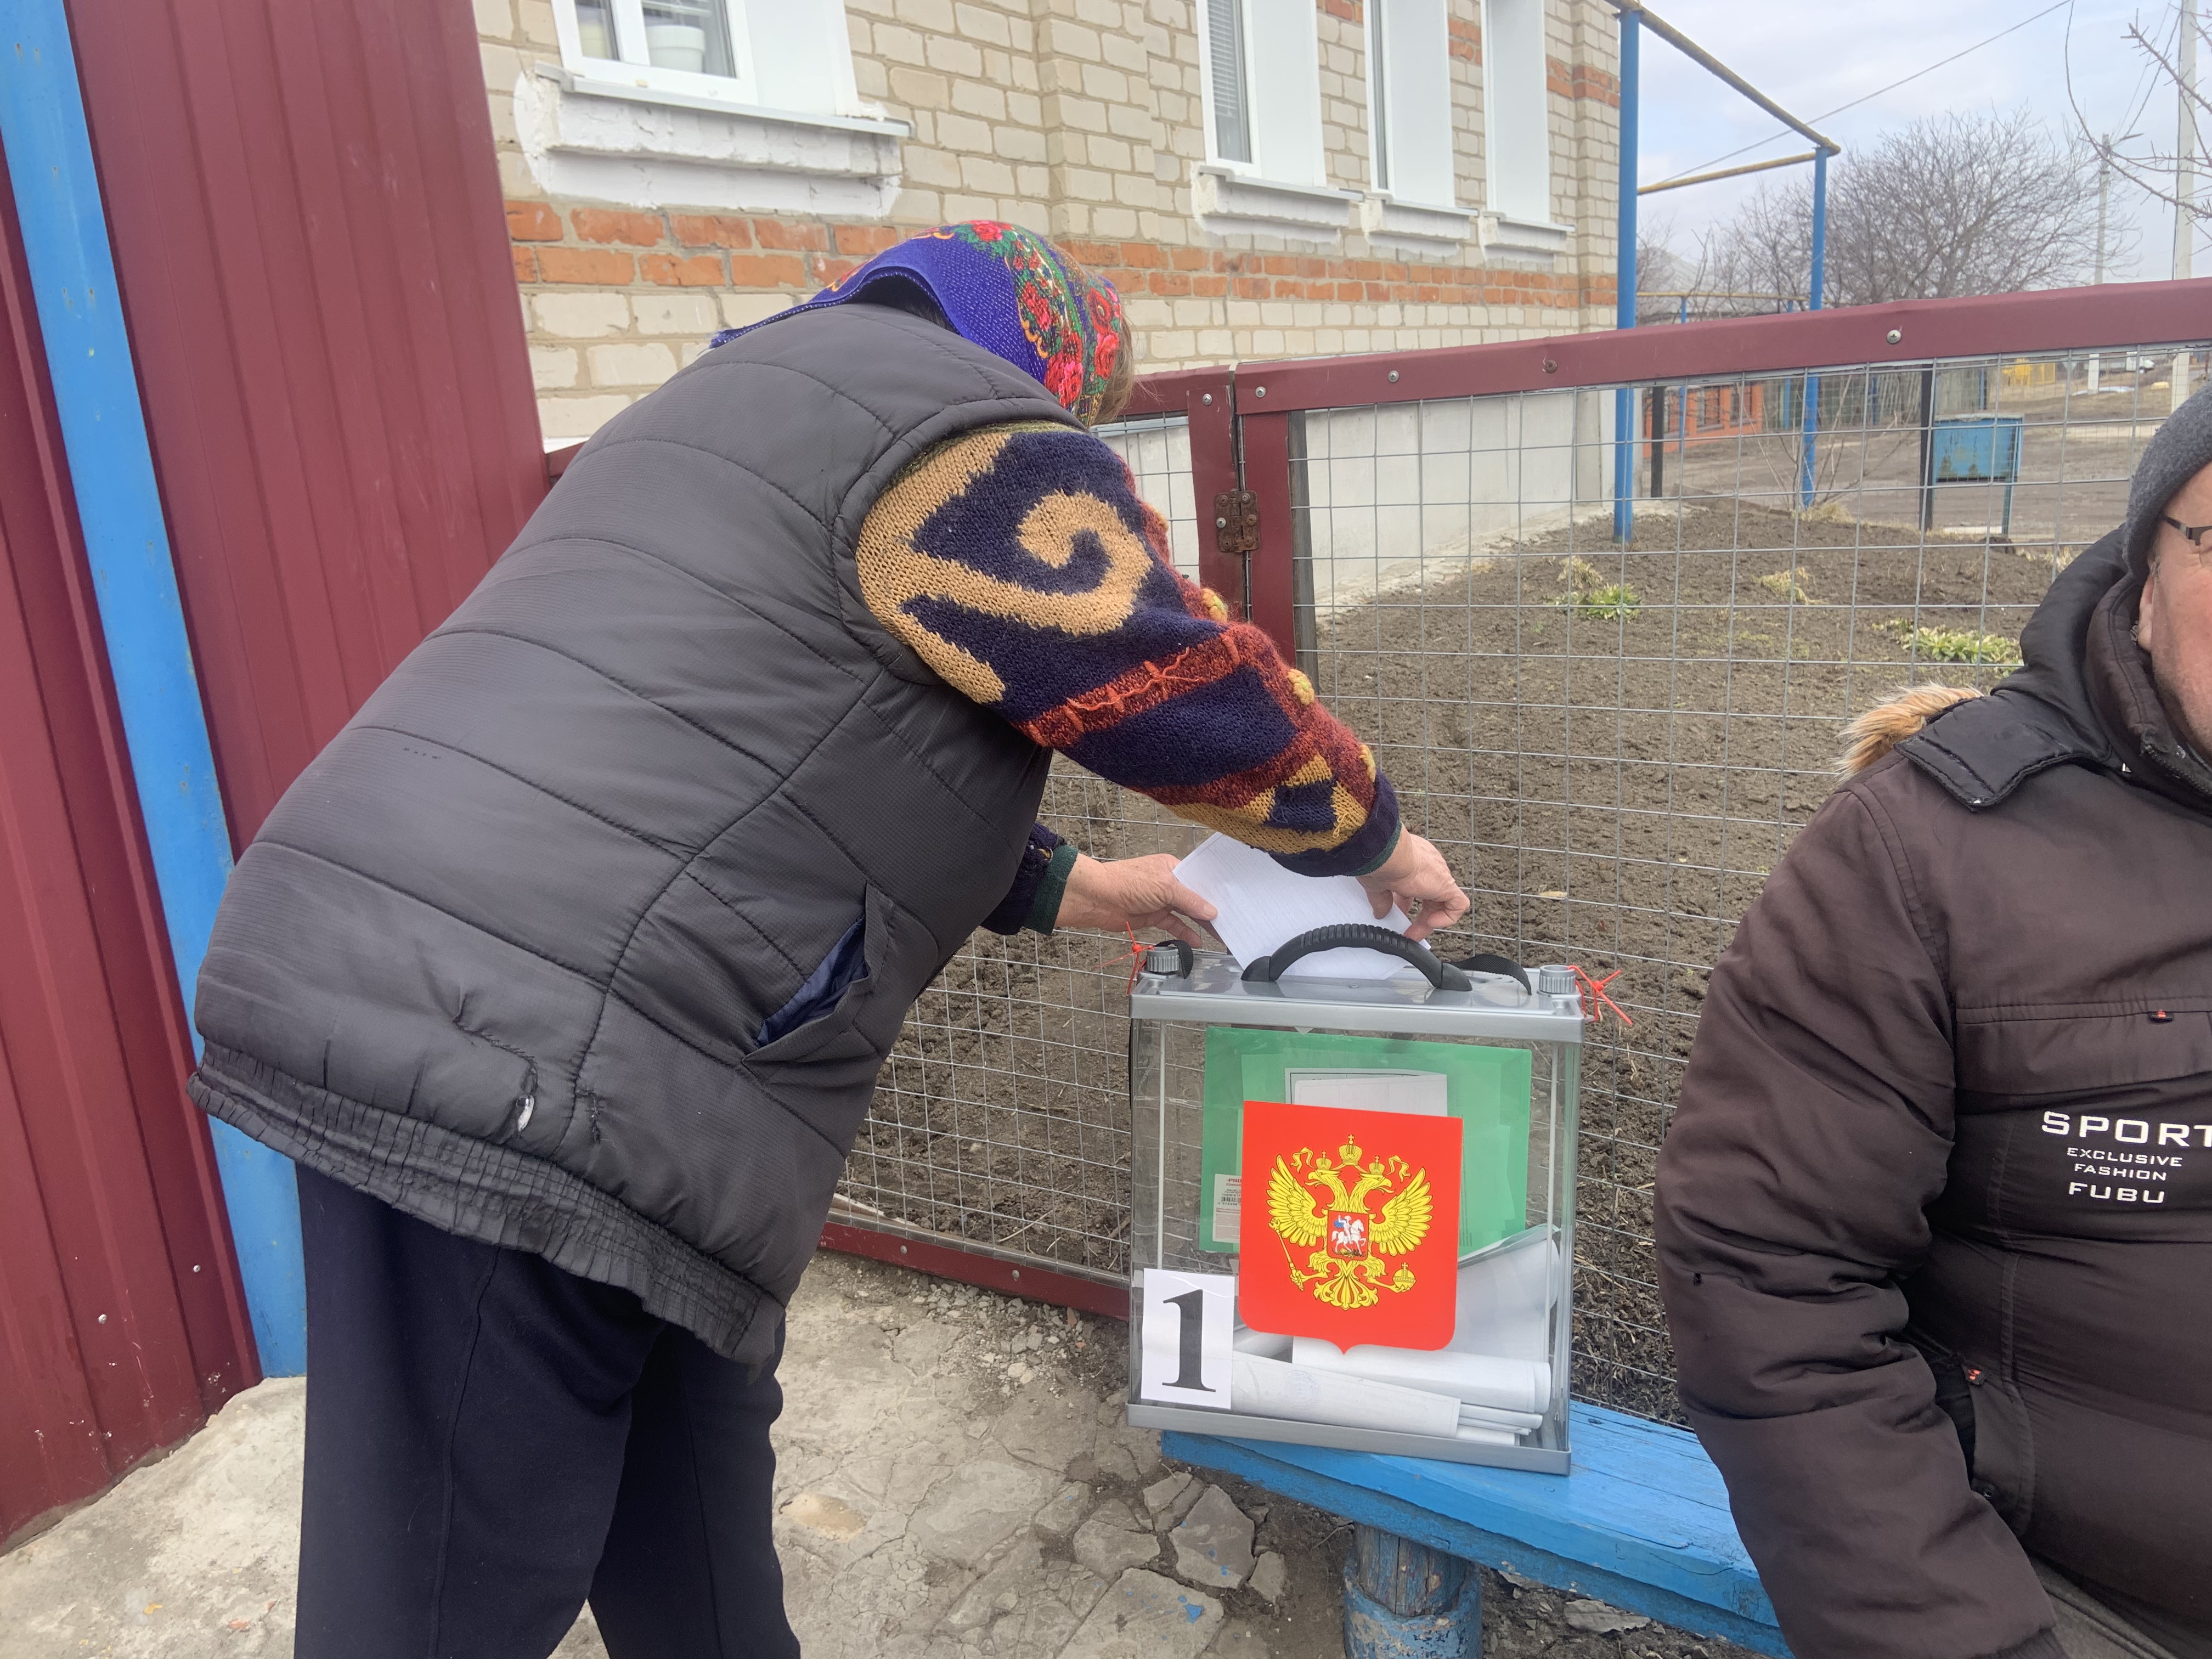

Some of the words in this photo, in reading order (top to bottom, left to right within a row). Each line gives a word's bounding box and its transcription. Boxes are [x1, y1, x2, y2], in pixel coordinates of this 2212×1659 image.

[2041, 1111, 2212, 1148] SPORT
[2067, 1147, 2183, 1167] EXCLUSIVE
[2074, 1163, 2167, 1181] FASHION
[2069, 1182, 2165, 1203] FUBU
[1162, 1289, 1216, 1392] 1
